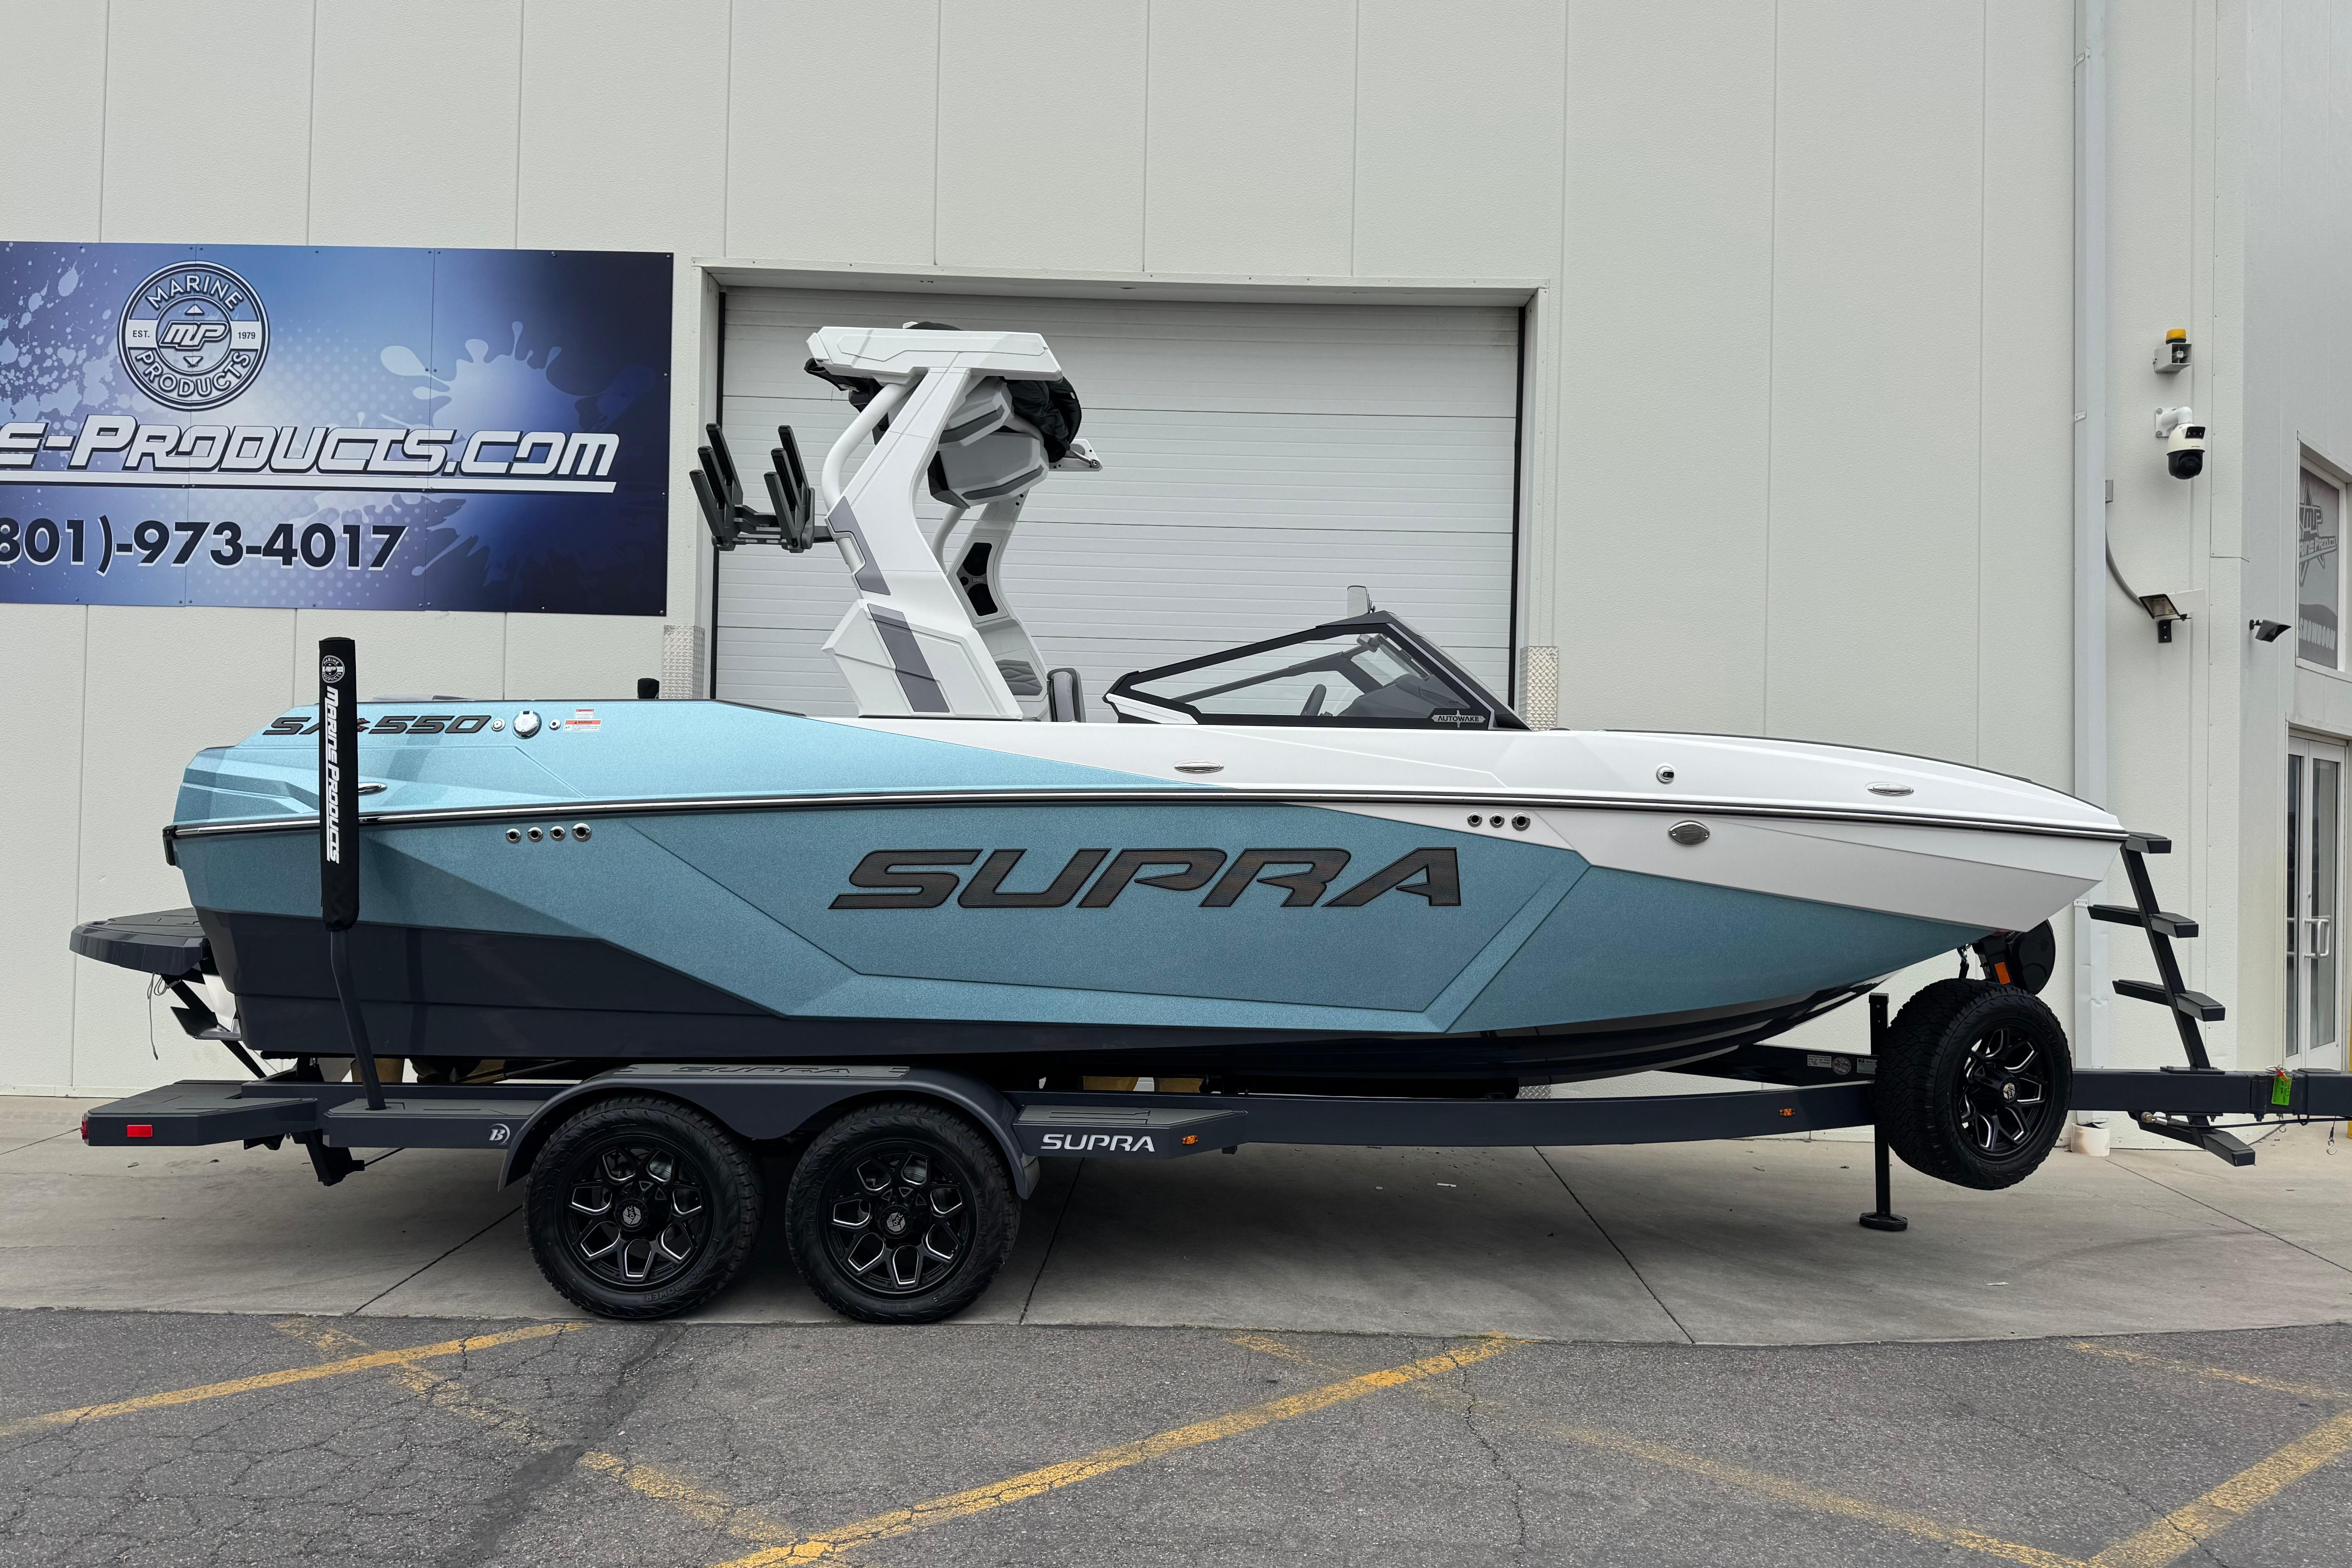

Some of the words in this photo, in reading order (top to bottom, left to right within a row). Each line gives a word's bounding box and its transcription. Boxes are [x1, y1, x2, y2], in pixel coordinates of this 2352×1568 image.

[146, 274, 244, 310] MARINE
[238, 331, 256, 340] 1979
[135, 350, 250, 397] PRODUCTS
[2299, 617, 2336, 651] SHOWROOM
[325, 686, 338, 763] MARINE
[369, 716, 492, 734] 550
[328, 763, 340, 864] PRODUCTS
[827, 847, 1462, 909] SUPRA
[1040, 1134, 1155, 1152] SUPRA
[645, 1285, 683, 1302] POWER
